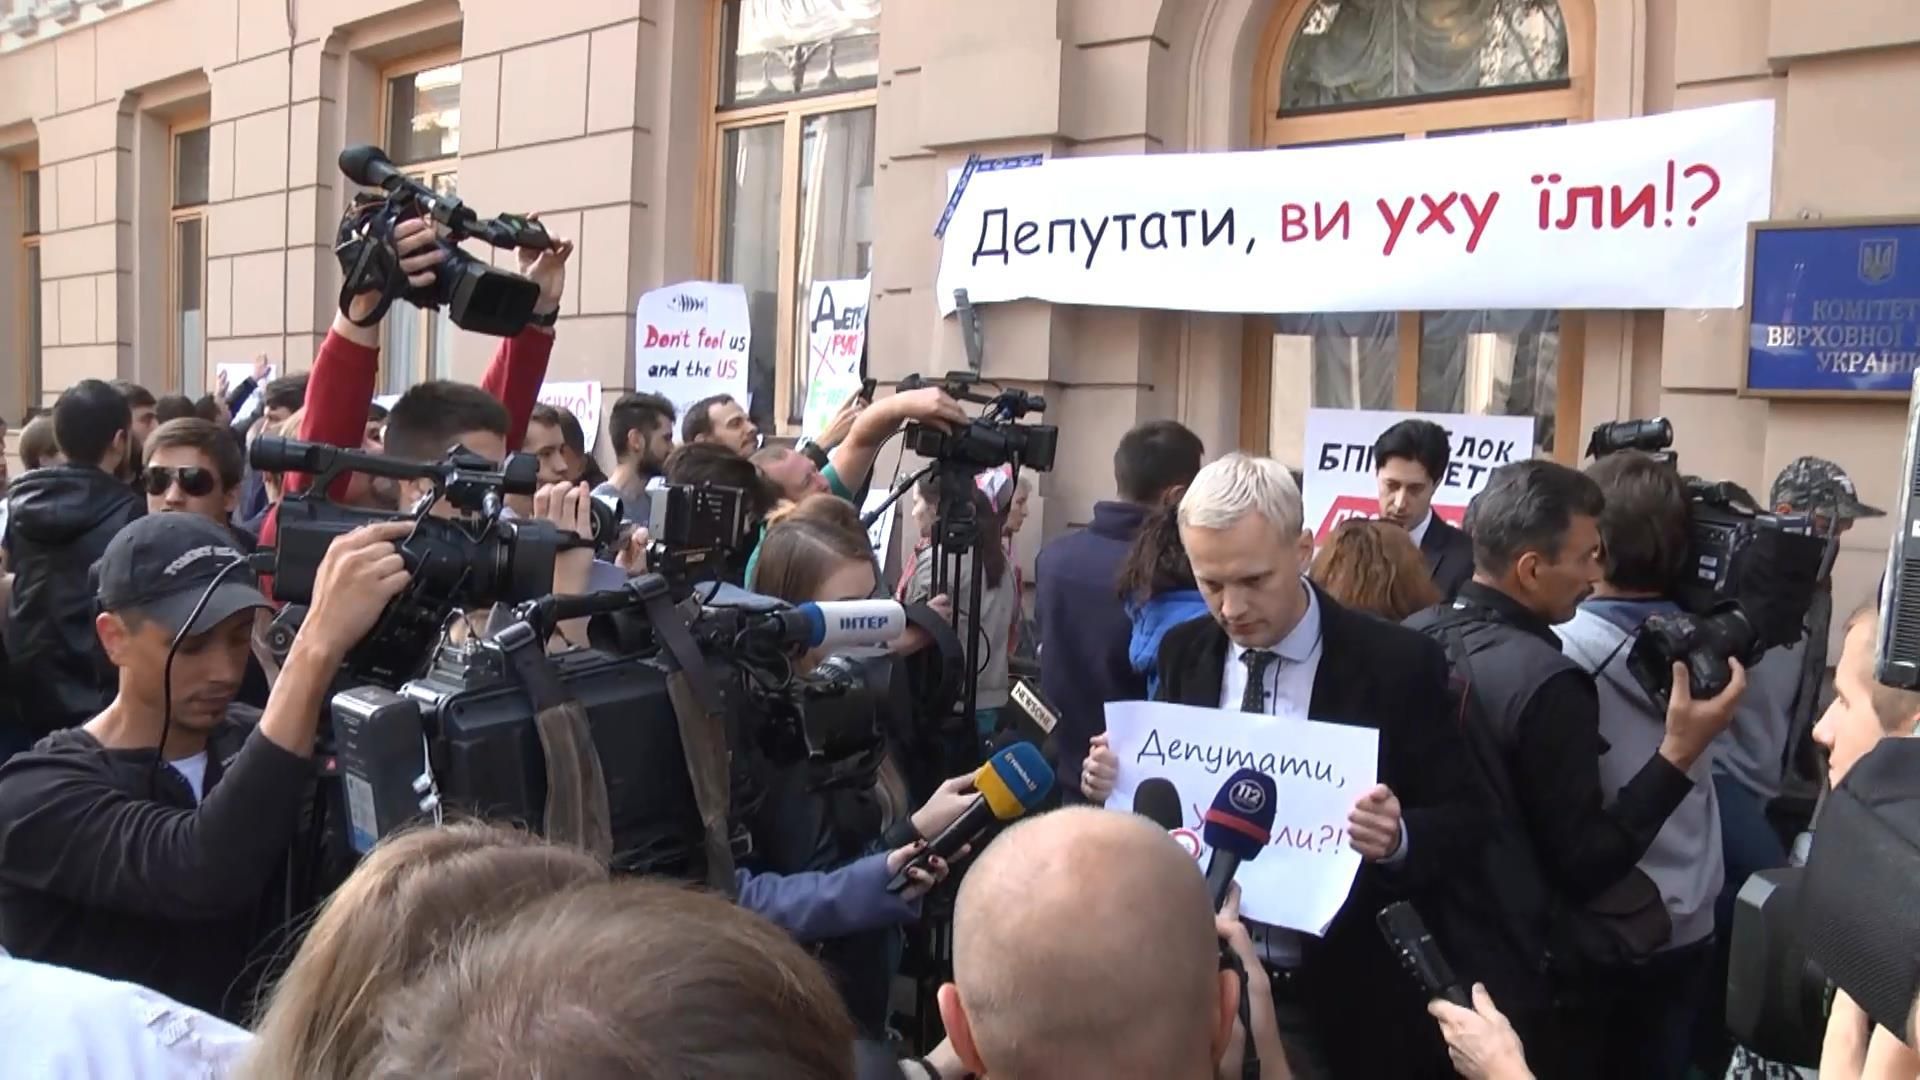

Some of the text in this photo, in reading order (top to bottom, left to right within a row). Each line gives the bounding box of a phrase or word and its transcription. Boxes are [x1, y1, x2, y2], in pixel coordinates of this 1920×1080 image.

[972, 160, 1721, 270] Депутати, ви уху їли!?
[644, 325, 746, 351] Don't fool us
[1766, 323, 1904, 348] ВЕРХОВНОЇ
[648, 360, 738, 379] and the US
[1446, 431, 1514, 463] ЛОК
[840, 615, 889, 630] ІНТЕР
[1137, 728, 1345, 789] Депутати,
[1237, 783, 1262, 804] 112
[1274, 824, 1344, 855] ли?!
